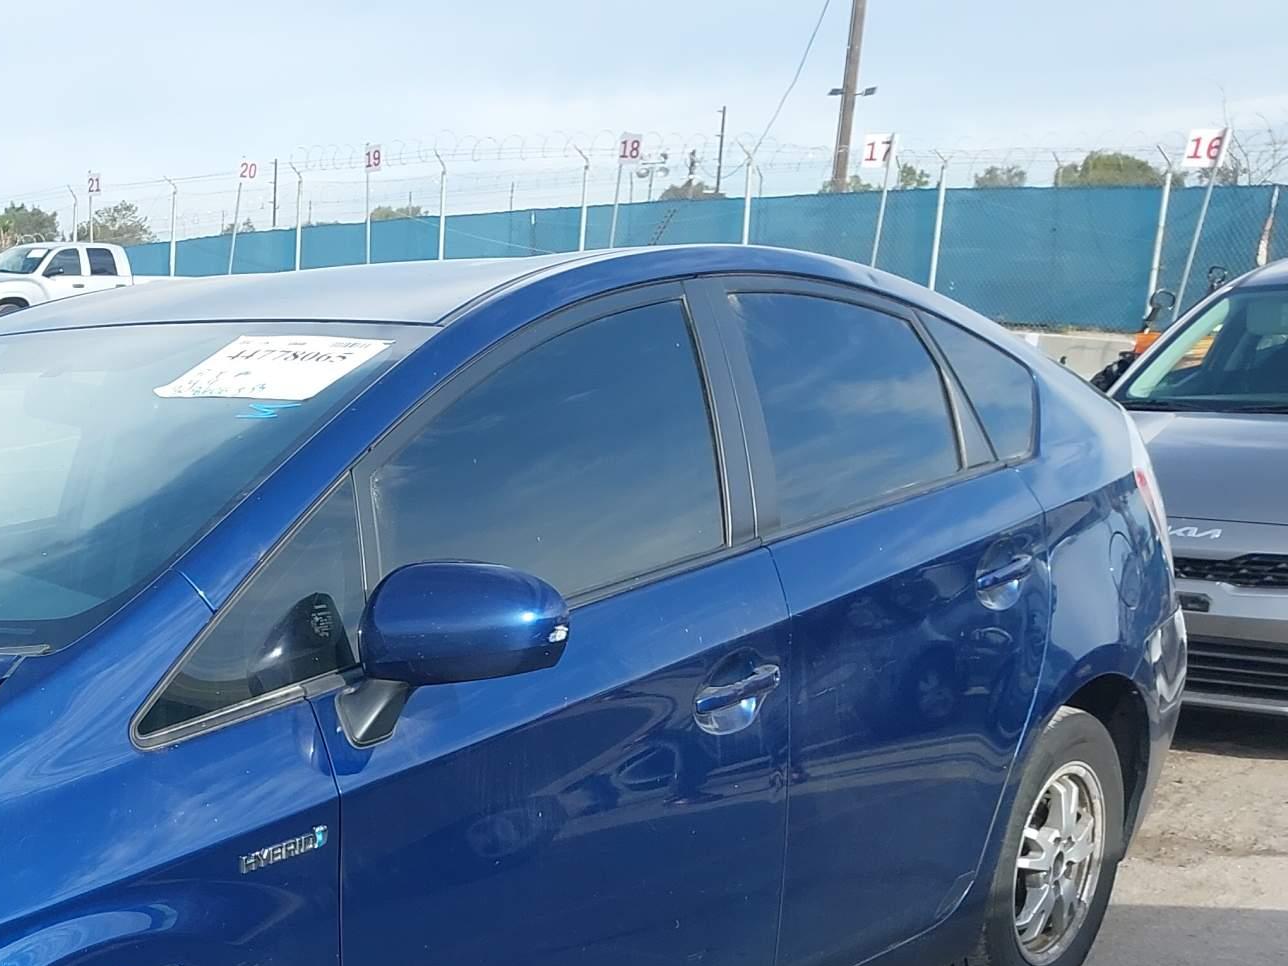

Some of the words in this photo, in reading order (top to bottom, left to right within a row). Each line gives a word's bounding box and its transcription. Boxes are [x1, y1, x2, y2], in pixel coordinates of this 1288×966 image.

[619, 139, 640, 159] 18
[864, 140, 892, 162] 17
[1186, 136, 1223, 160] 16
[365, 149, 381, 168] 19
[240, 162, 257, 179] 20
[87, 177, 101, 193] 21
[227, 349, 354, 364] 44778065
[240, 833, 315, 874] HYBRID
